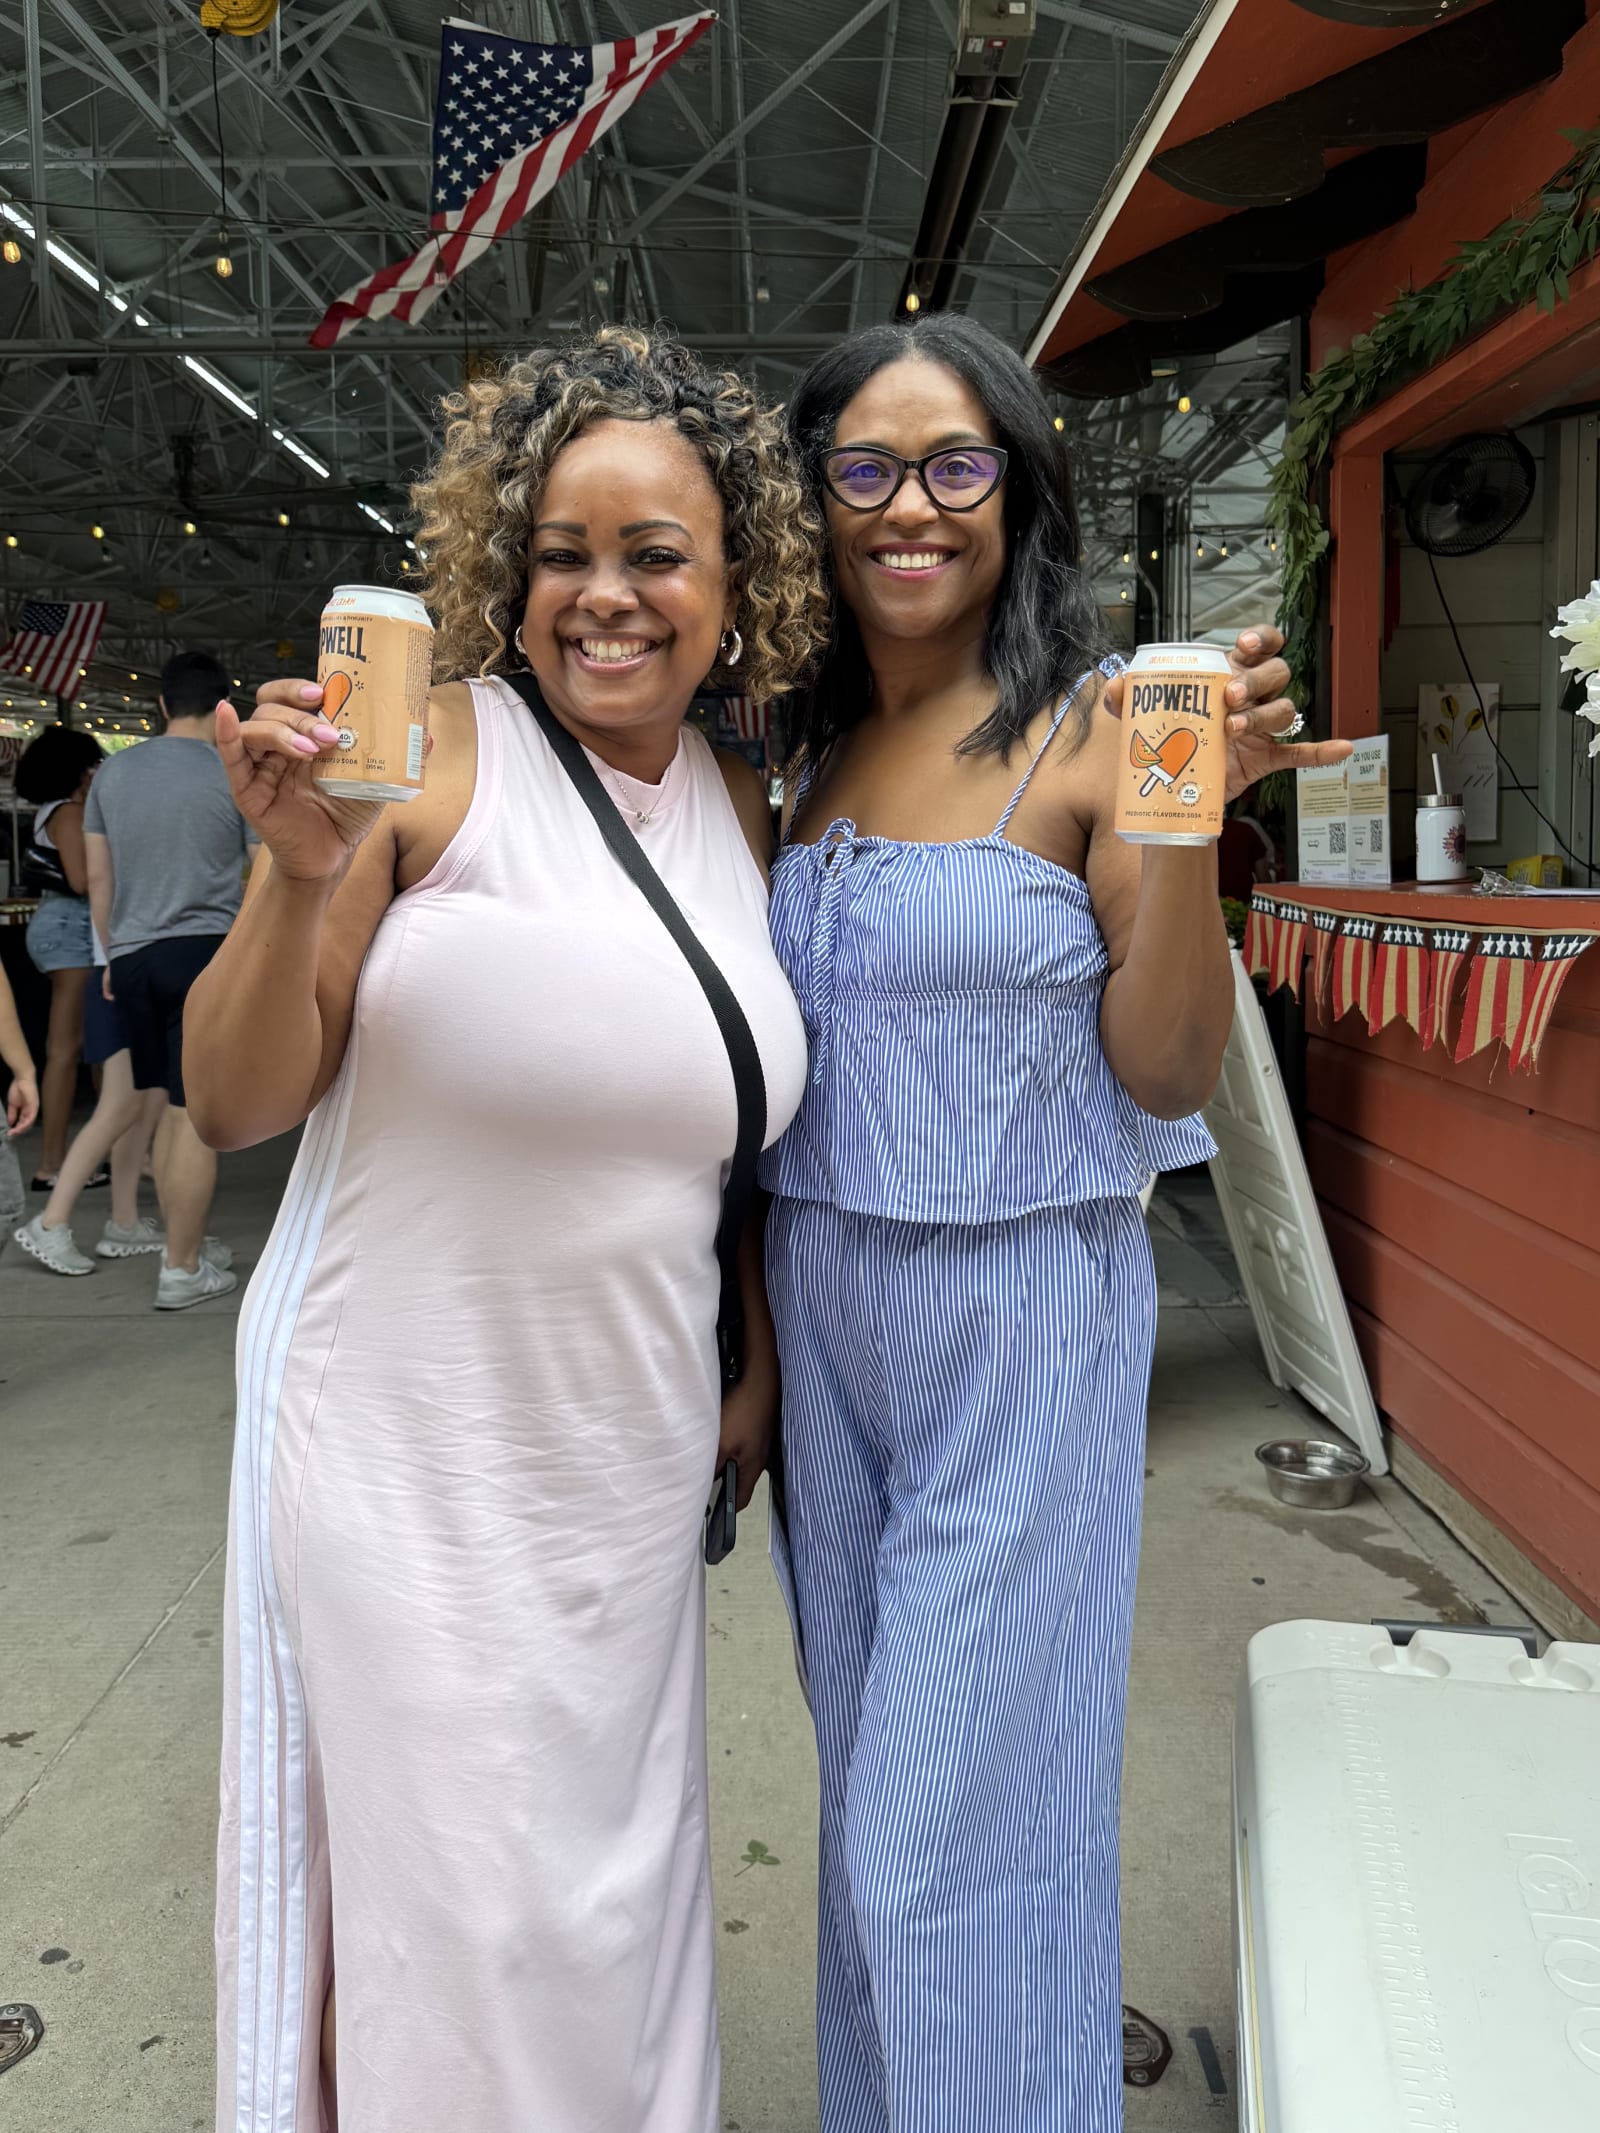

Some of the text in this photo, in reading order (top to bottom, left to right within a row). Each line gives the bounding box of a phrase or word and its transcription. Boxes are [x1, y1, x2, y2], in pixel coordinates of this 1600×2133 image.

[320, 626, 367, 663] PWELL
[1131, 684, 1211, 720] POPWELL
[1361, 751, 1370, 761] YOU
